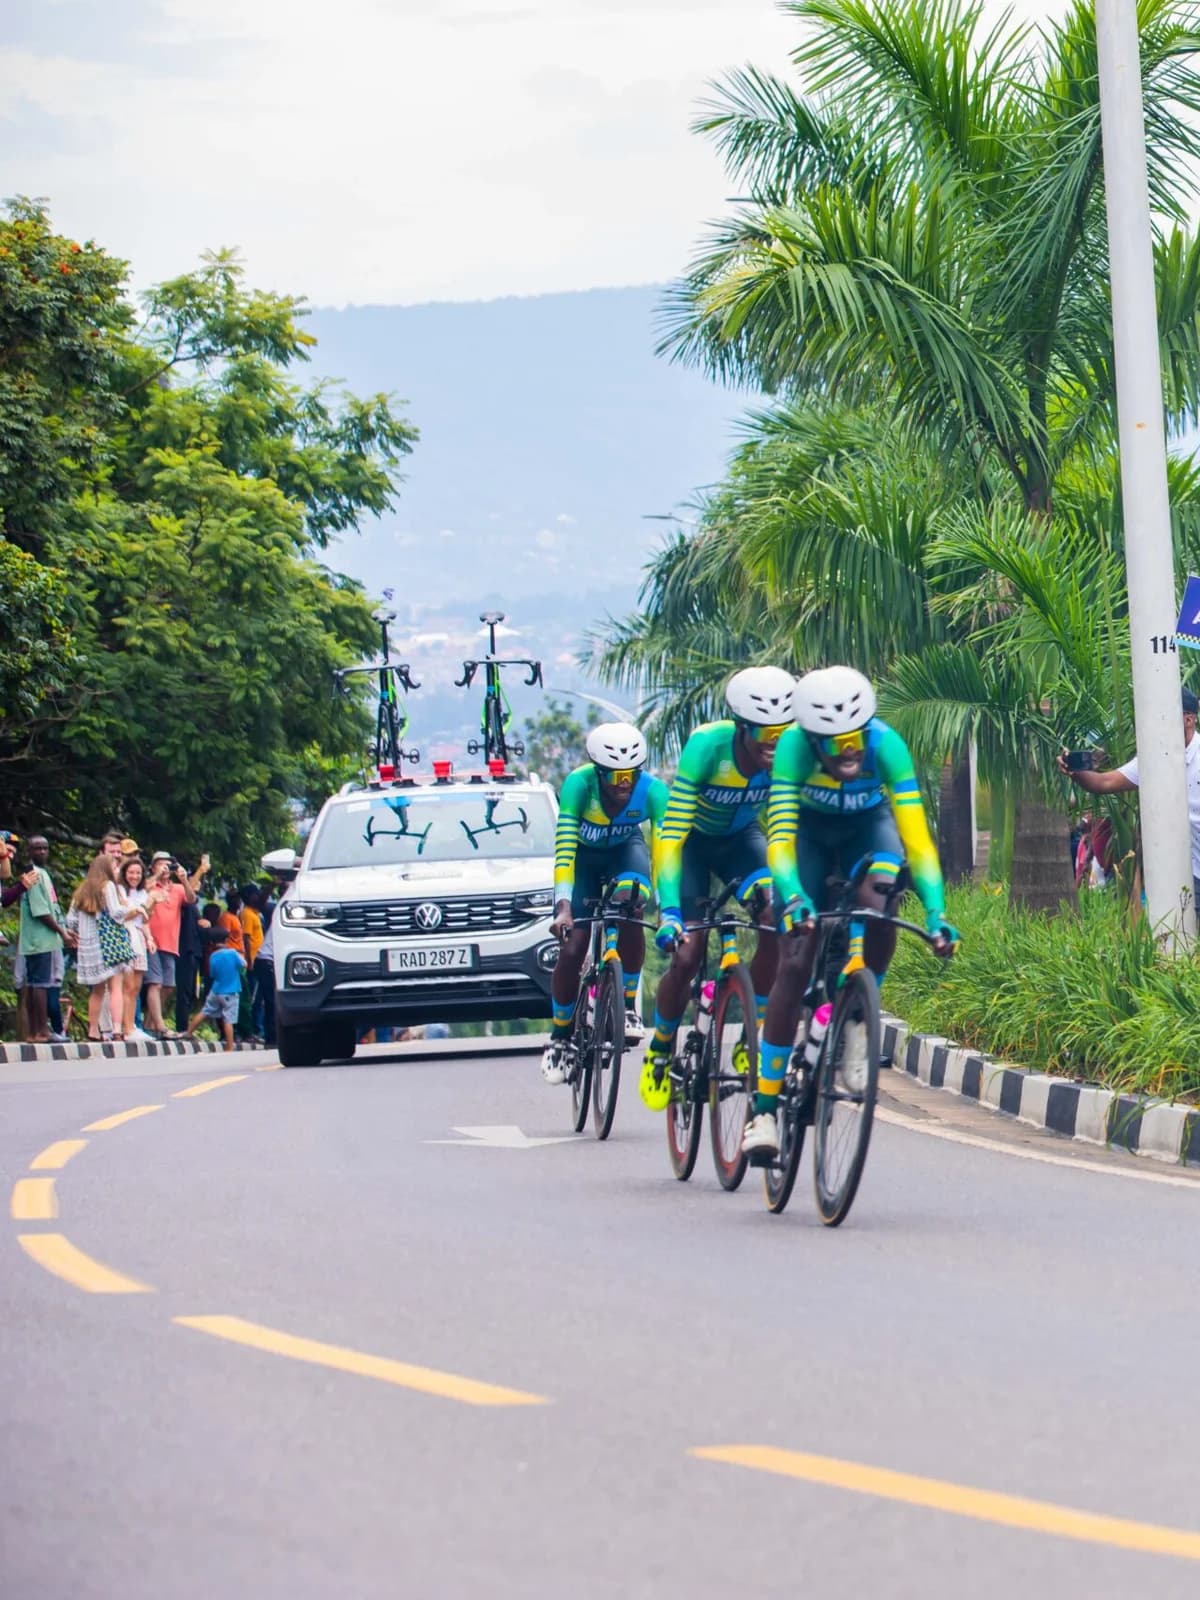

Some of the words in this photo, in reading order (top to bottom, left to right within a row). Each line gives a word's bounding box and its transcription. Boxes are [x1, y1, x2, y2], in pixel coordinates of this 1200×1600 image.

[399, 951, 427, 968] RAD
[429, 949, 455, 966] 287
[458, 949, 467, 965] Z
